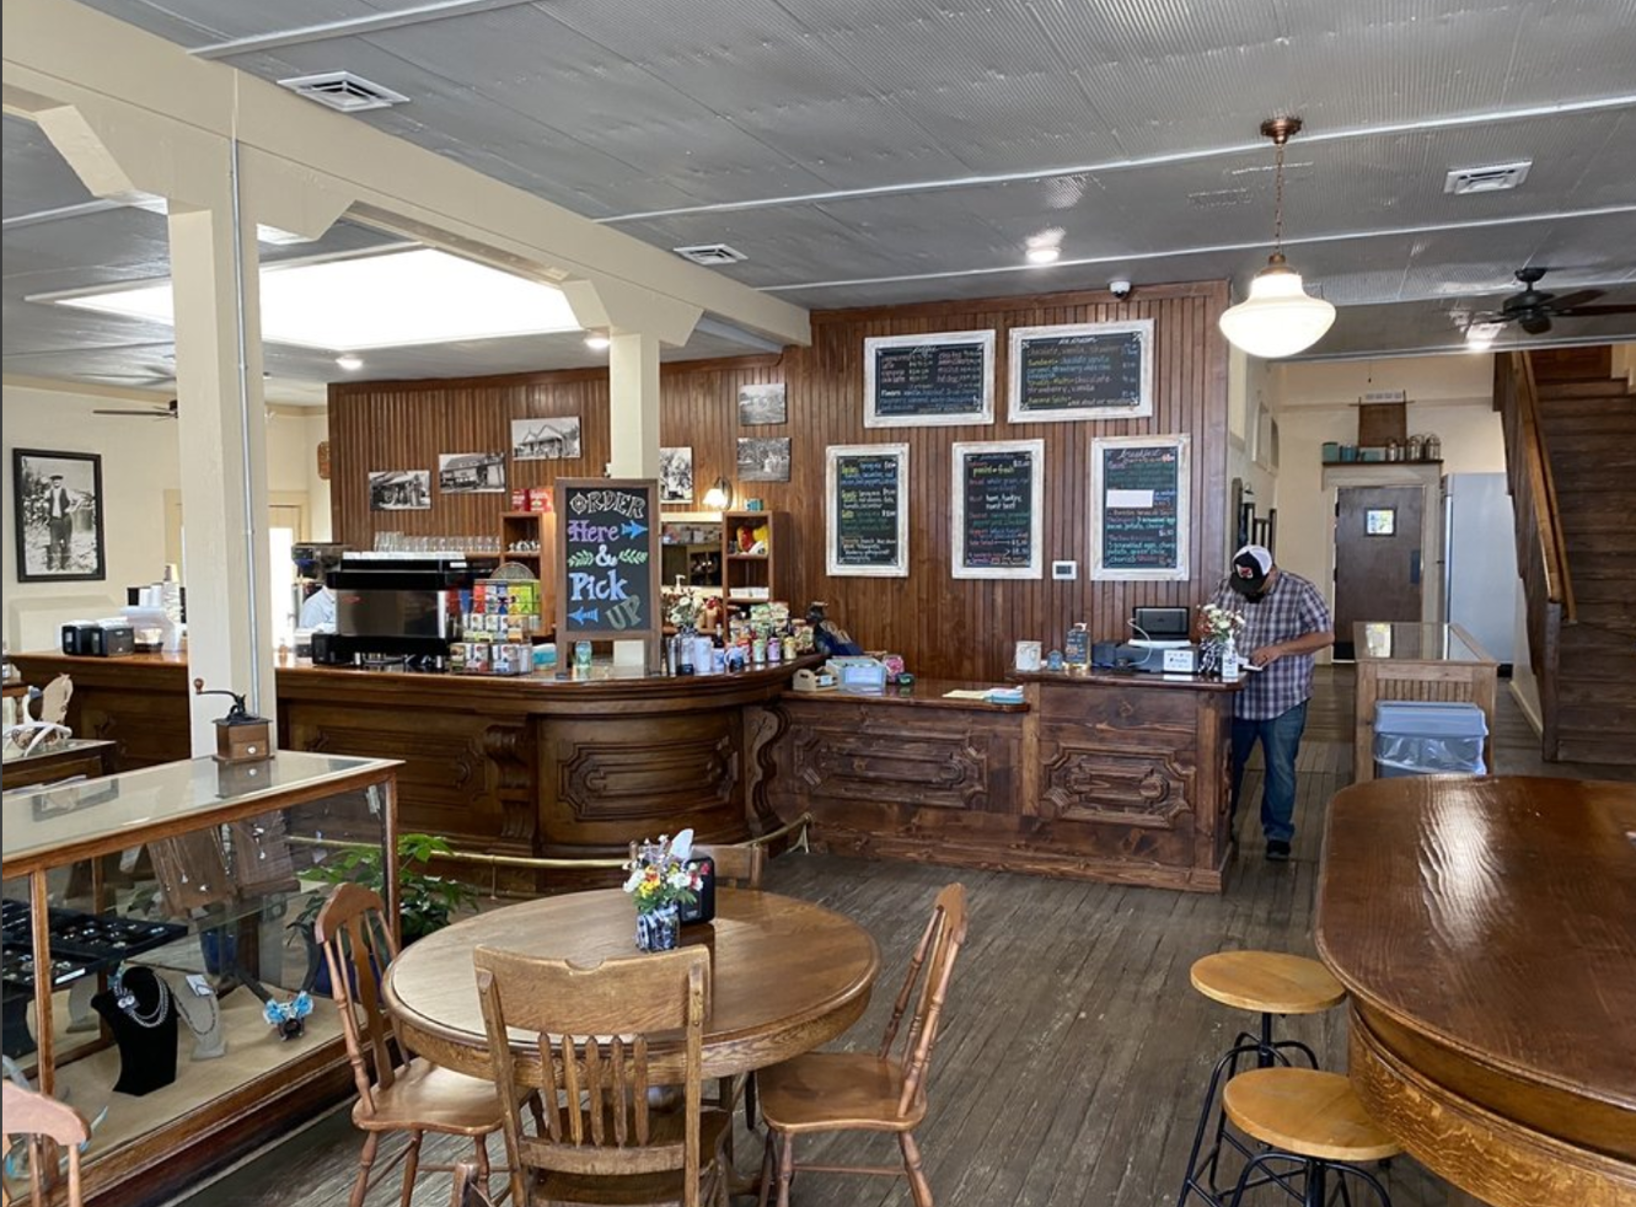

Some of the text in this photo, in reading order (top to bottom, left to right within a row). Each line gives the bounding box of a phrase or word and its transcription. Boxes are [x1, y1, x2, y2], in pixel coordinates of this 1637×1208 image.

[569, 489, 646, 519] ORDER
[567, 519, 620, 543] Here
[595, 544, 618, 567] &
[568, 569, 628, 602] Pick
[605, 594, 642, 630] UP
